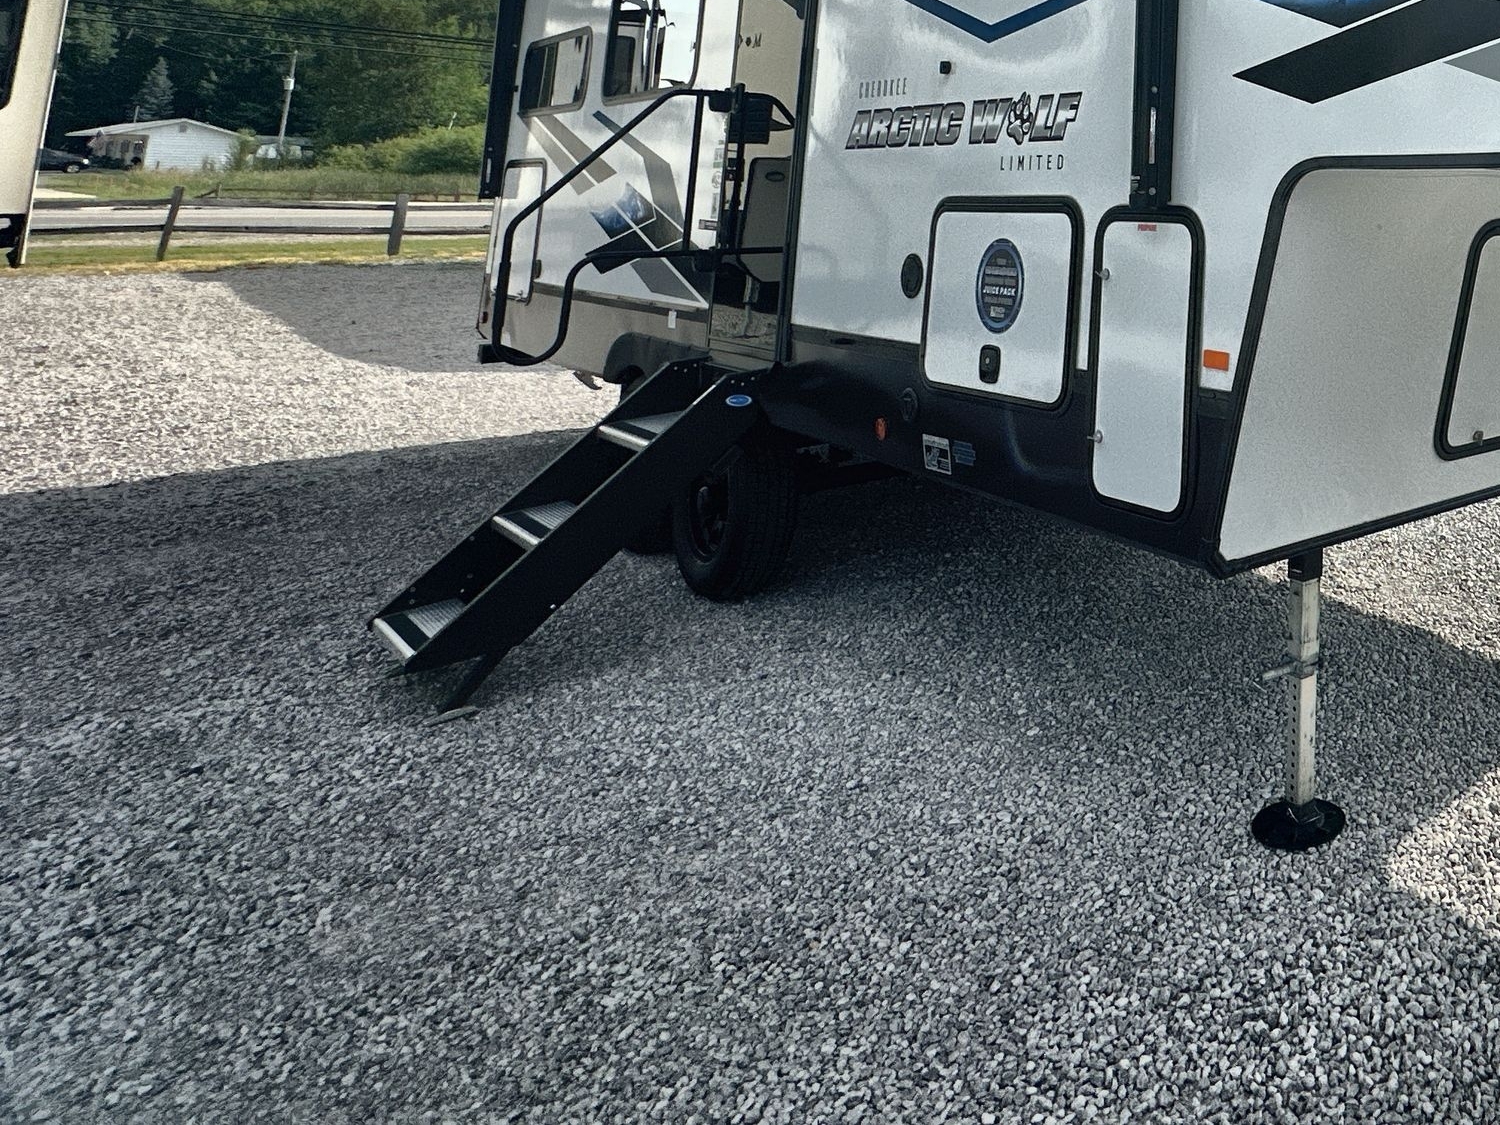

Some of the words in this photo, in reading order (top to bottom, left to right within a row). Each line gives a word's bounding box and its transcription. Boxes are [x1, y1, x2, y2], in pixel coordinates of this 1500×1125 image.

[858, 77, 908, 100] CHEROKEE
[845, 101, 966, 150] ARCTIC
[999, 154, 1065, 172] LIMITED
[999, 287, 1016, 296] PACK
